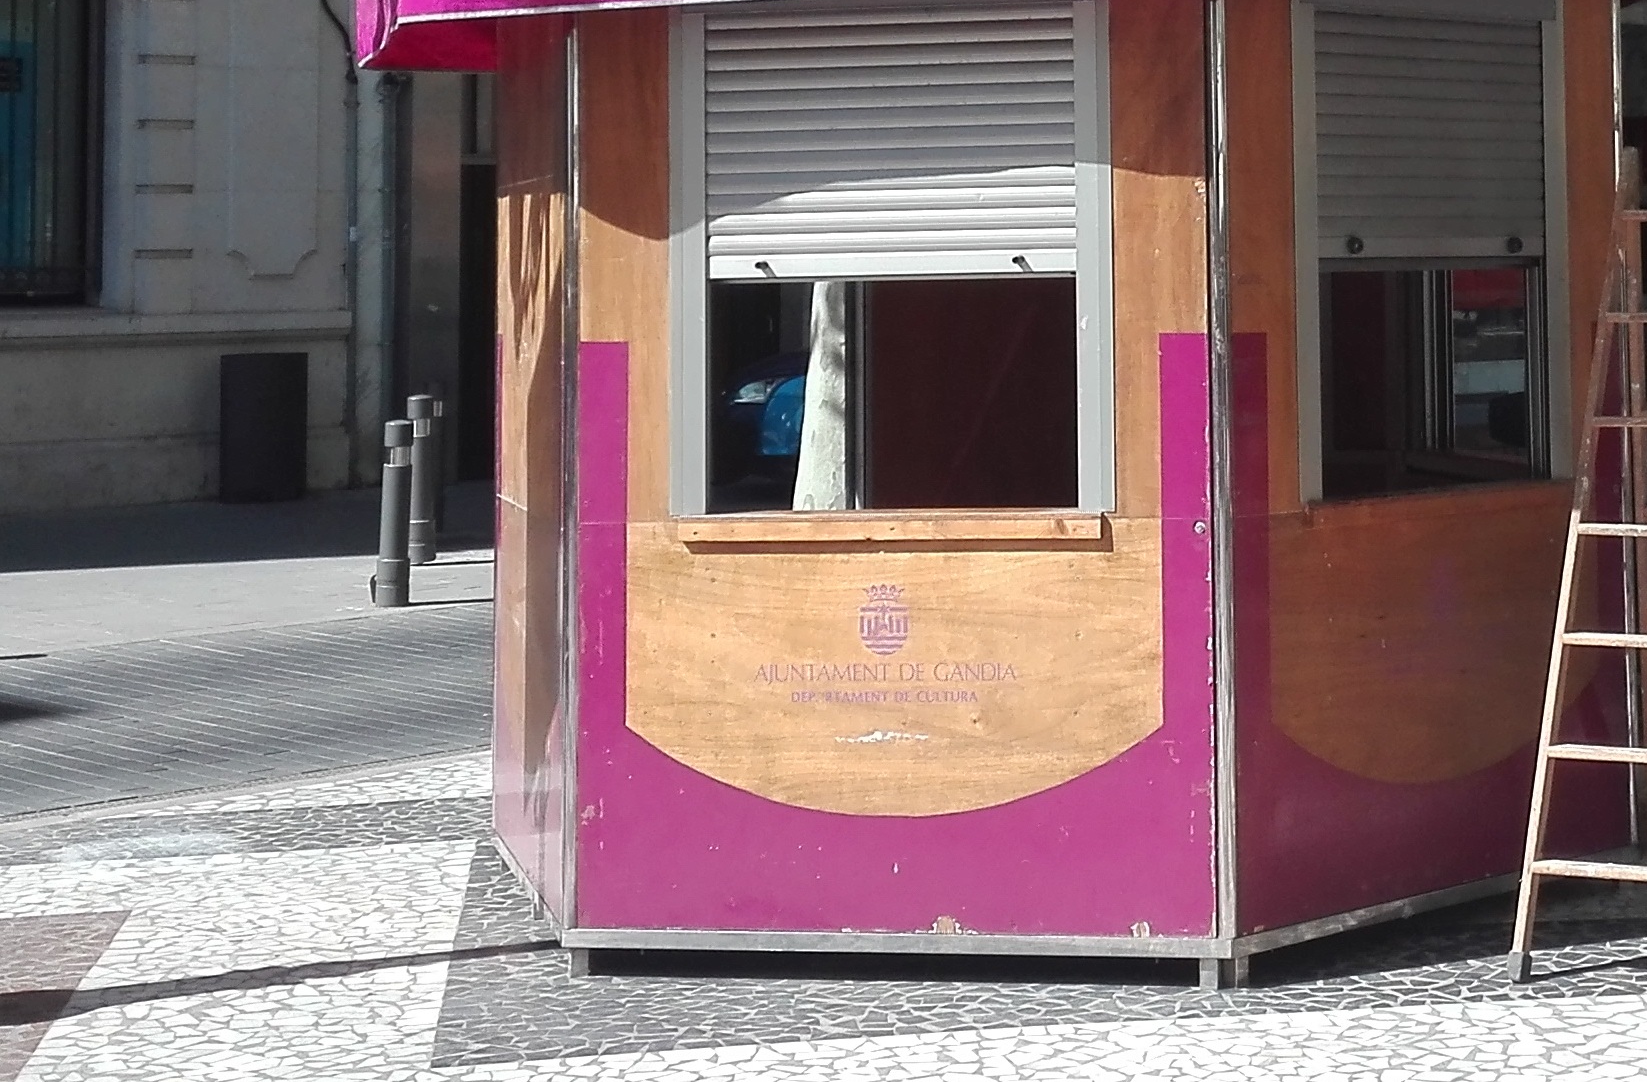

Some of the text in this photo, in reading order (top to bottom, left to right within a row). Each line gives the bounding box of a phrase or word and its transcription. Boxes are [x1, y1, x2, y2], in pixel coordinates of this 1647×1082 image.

[753, 662, 1016, 684] AJUNTAMENT DE GANDIA
[791, 690, 977, 703] DEPRTAMENT DE CULTURA
